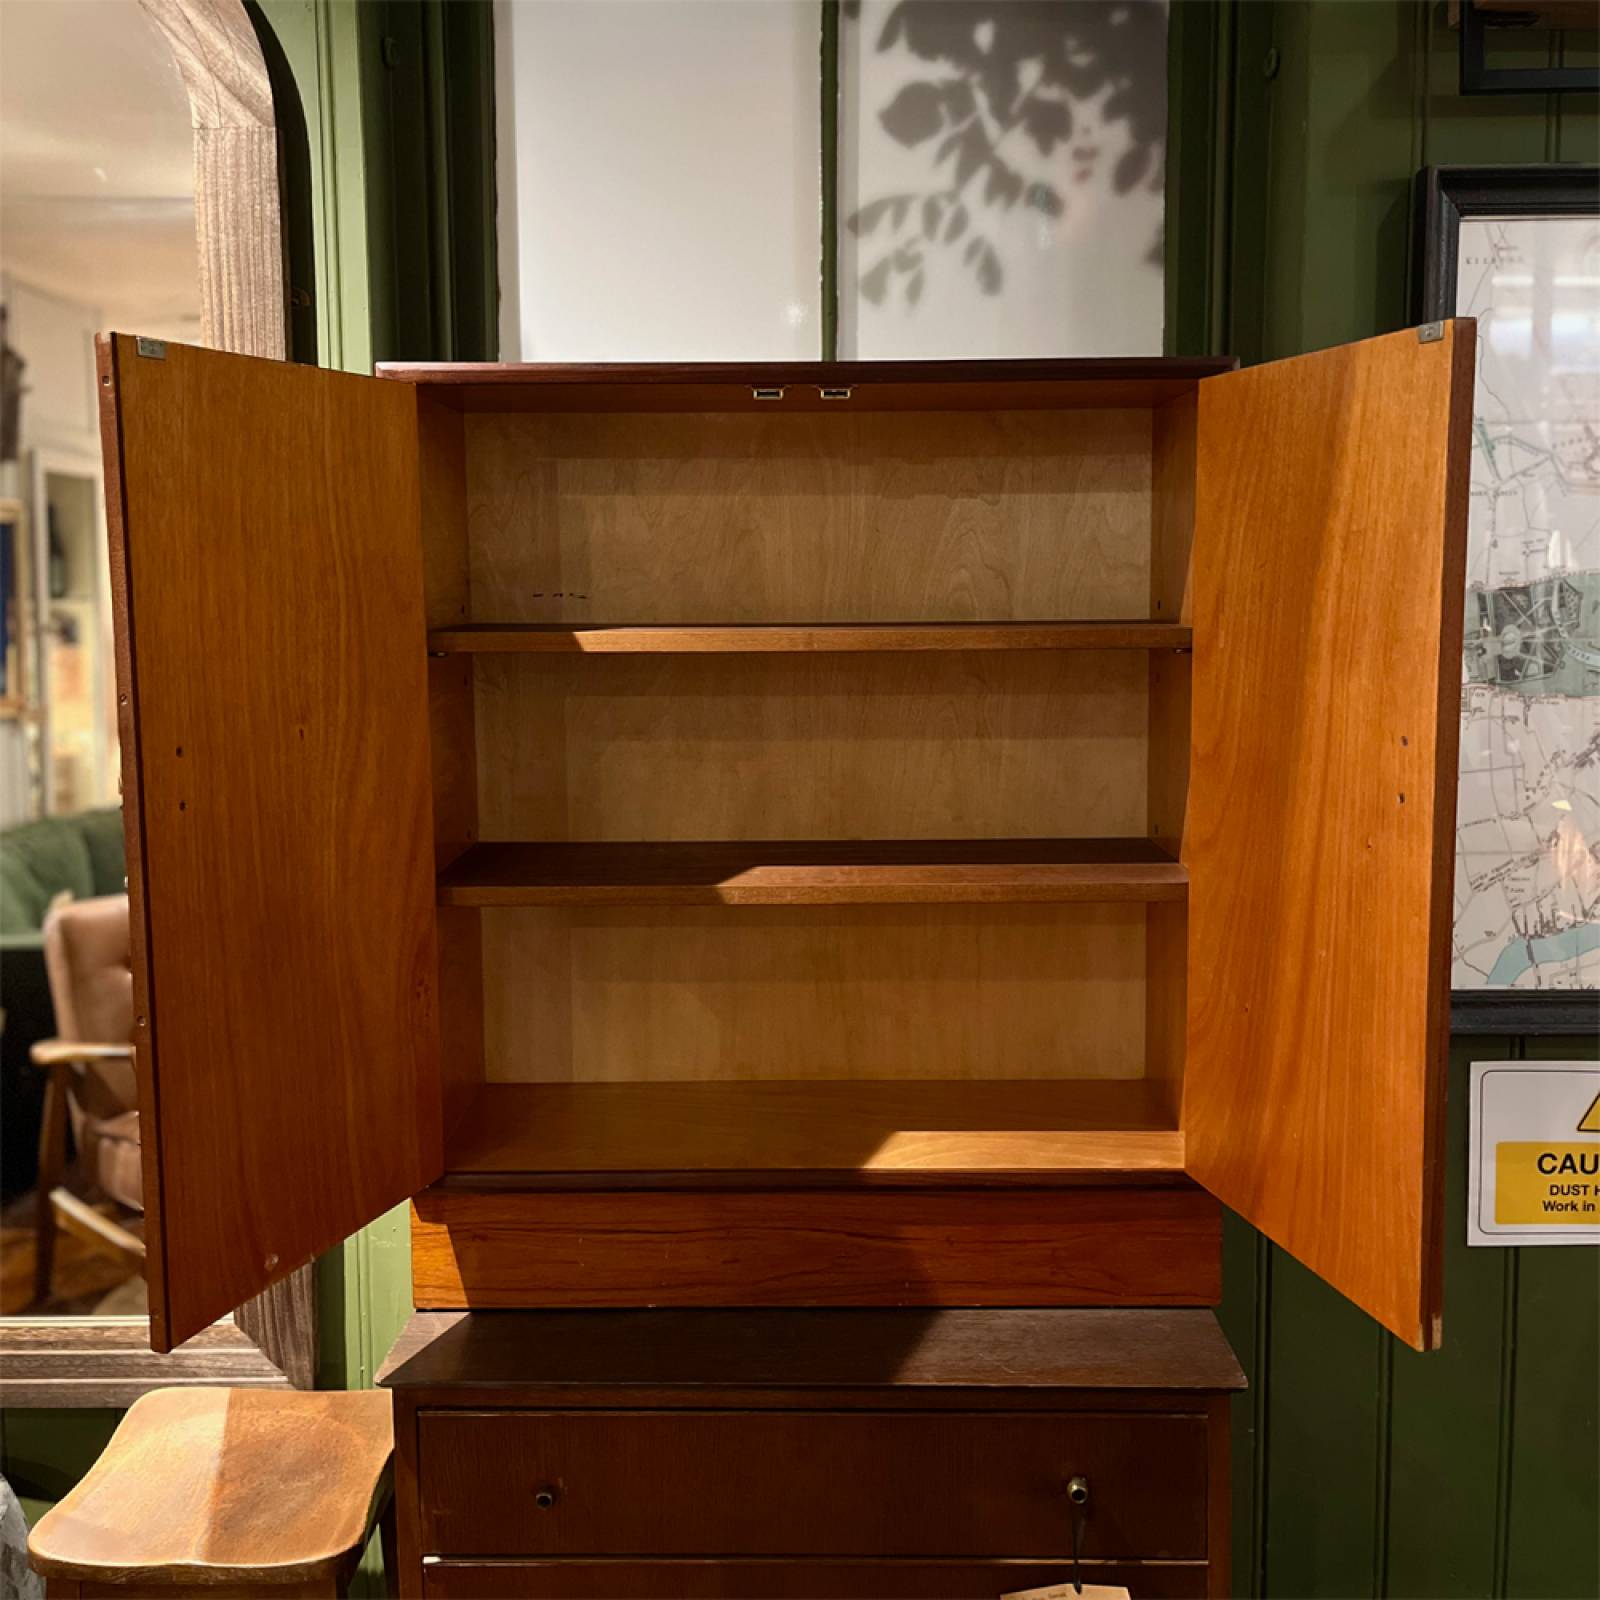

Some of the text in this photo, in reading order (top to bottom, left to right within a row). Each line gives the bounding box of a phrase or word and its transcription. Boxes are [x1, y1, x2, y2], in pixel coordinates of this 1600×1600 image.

[1537, 1152, 1599, 1175] CAU
[1549, 1184, 1591, 1196] DUST
[1542, 1200, 1596, 1212] Work in
